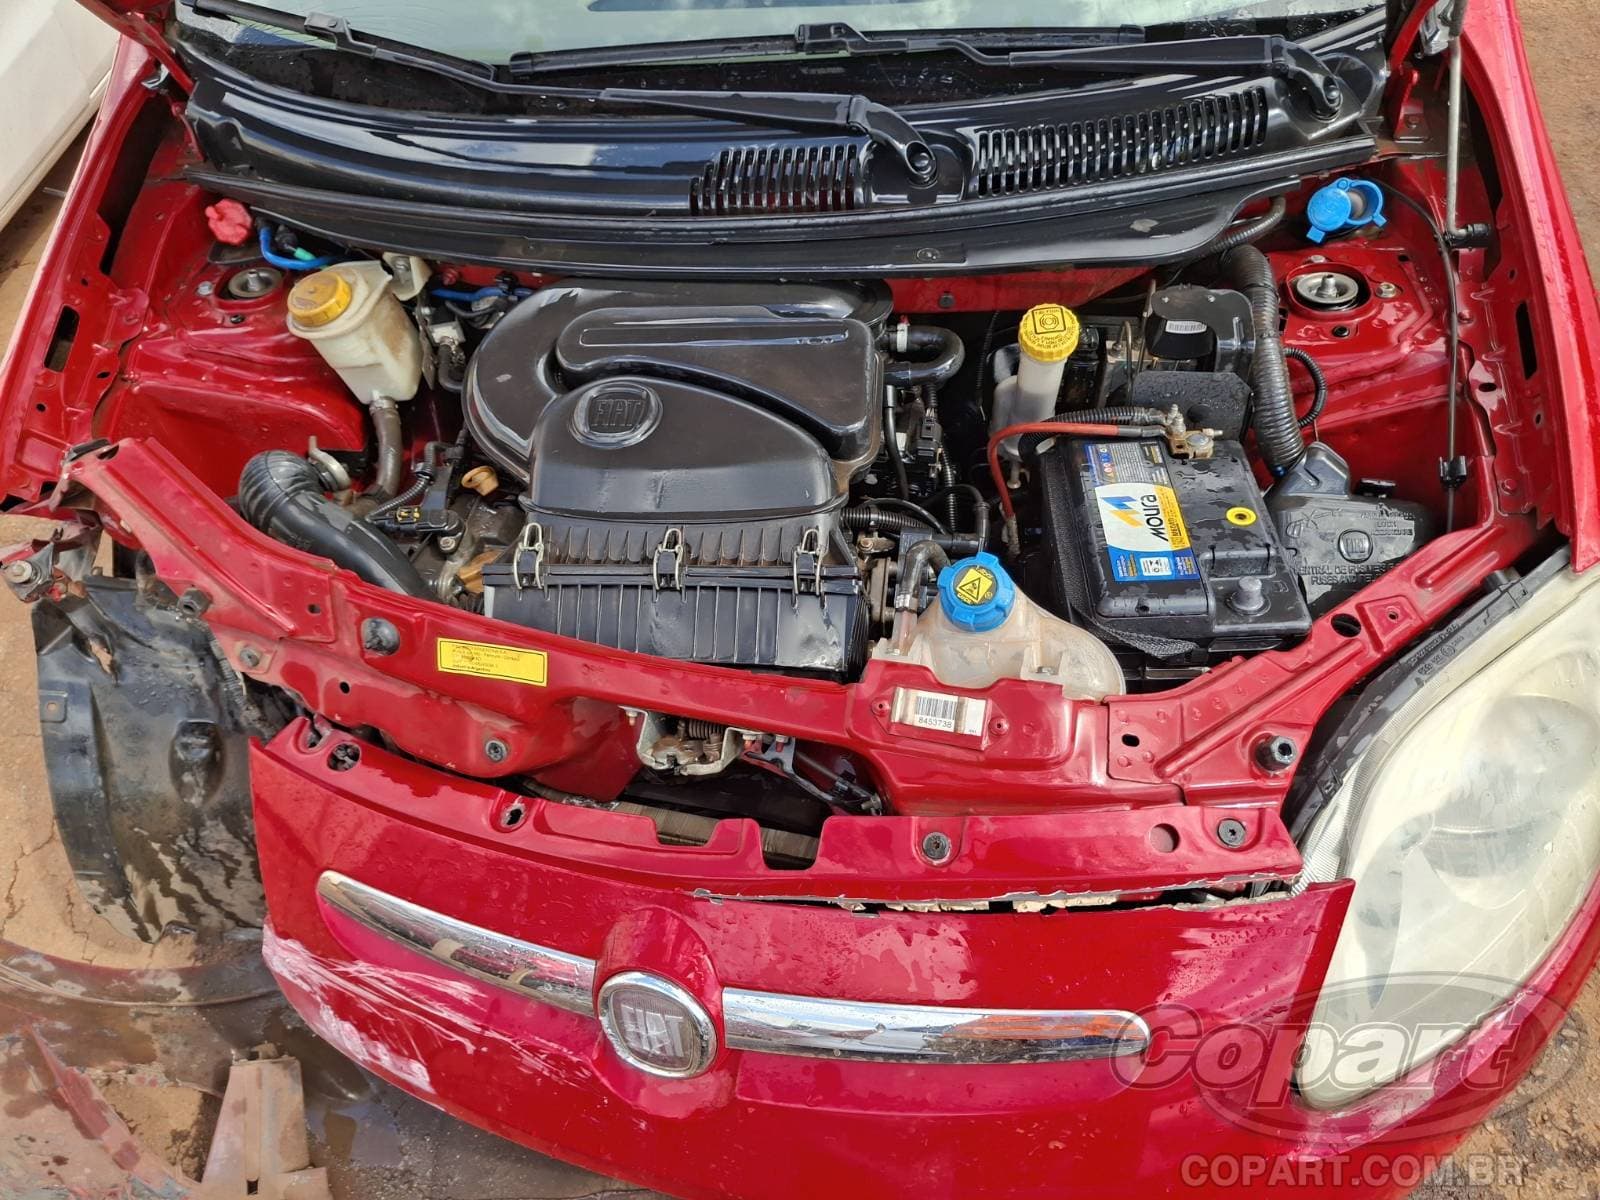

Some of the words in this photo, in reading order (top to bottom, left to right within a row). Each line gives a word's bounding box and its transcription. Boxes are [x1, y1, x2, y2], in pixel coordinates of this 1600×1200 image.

[591, 398, 643, 428] FIAT
[918, 717, 953, 730] 8453738
[620, 1003, 686, 1058] FIAT
